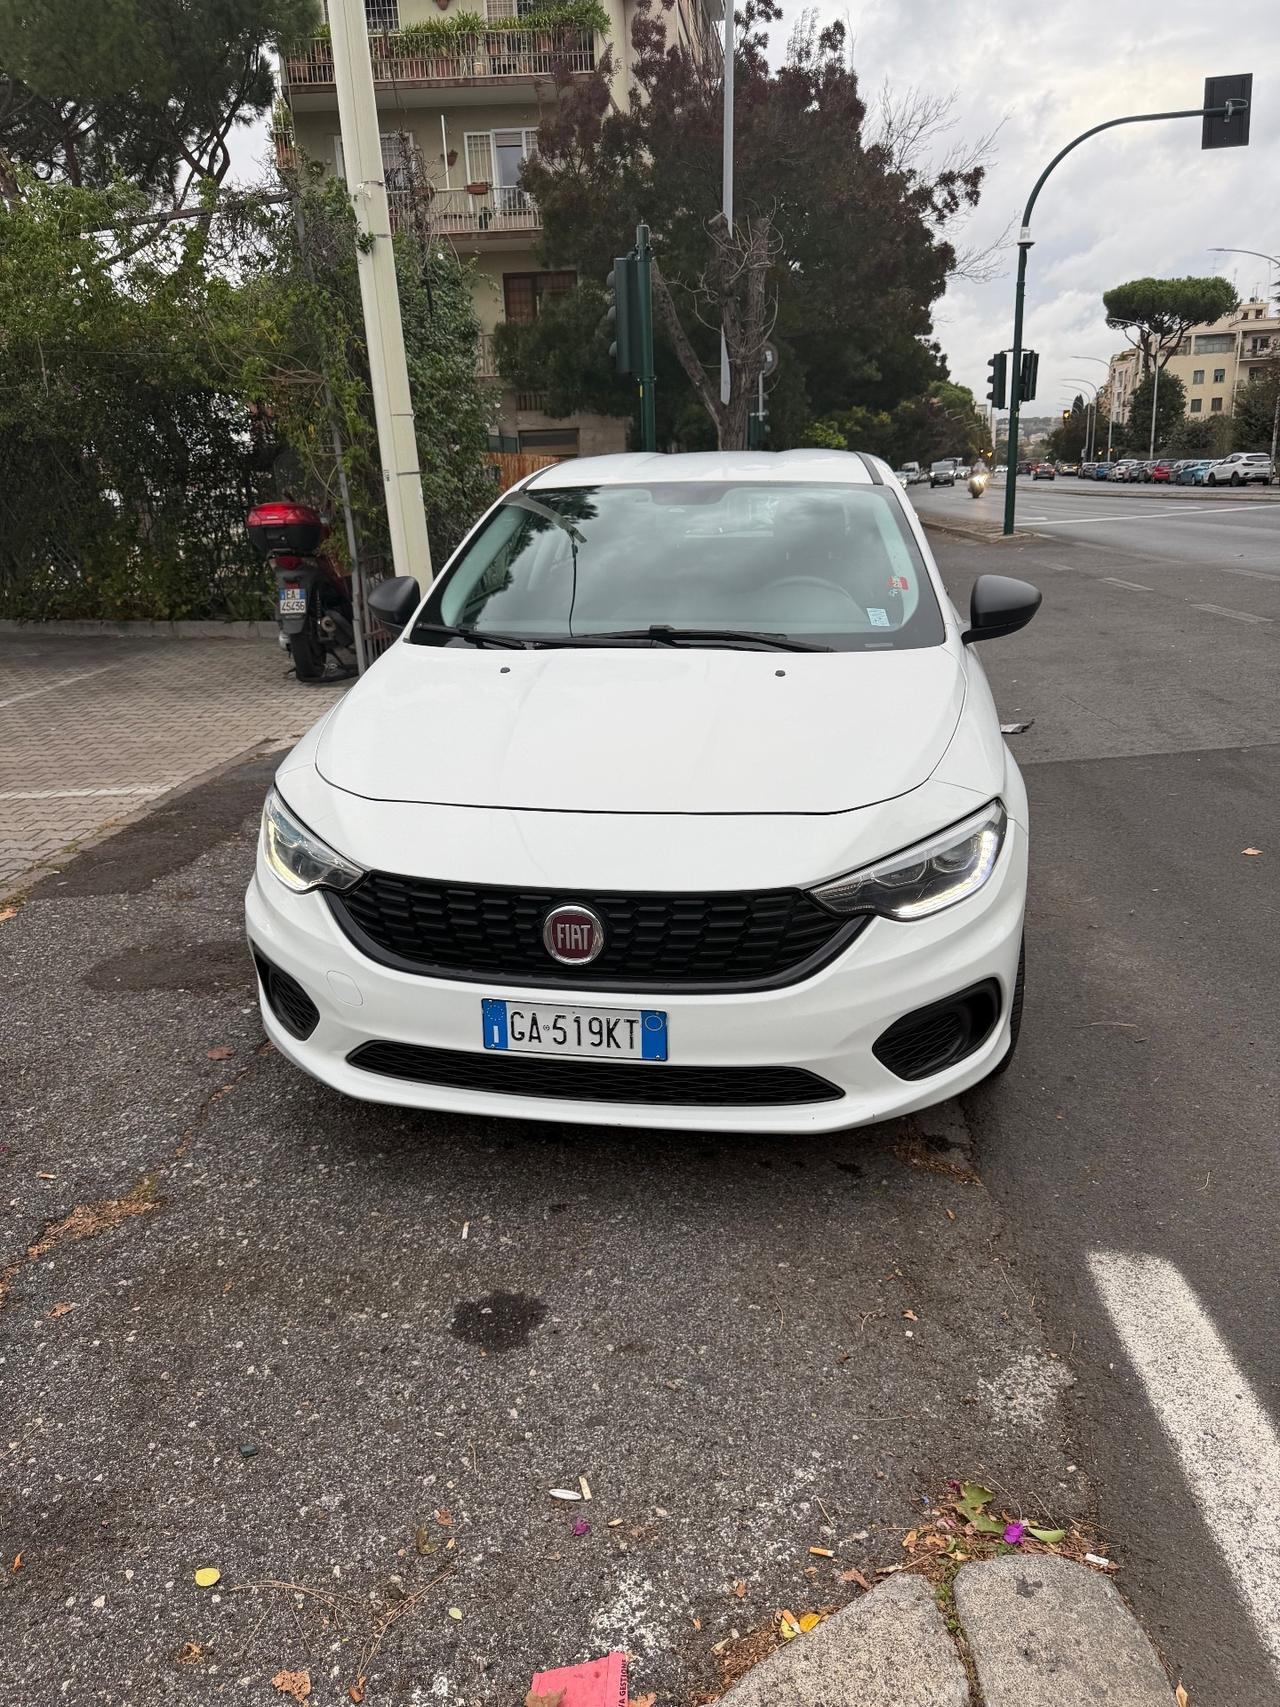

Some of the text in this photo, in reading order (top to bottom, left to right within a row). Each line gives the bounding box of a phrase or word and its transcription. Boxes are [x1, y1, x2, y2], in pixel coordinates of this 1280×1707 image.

[286, 590, 296, 600] EA
[557, 924, 591, 950] FIAT
[510, 1011, 639, 1049] GA 519KT
[619, 1659, 627, 1696] GESTIONE
